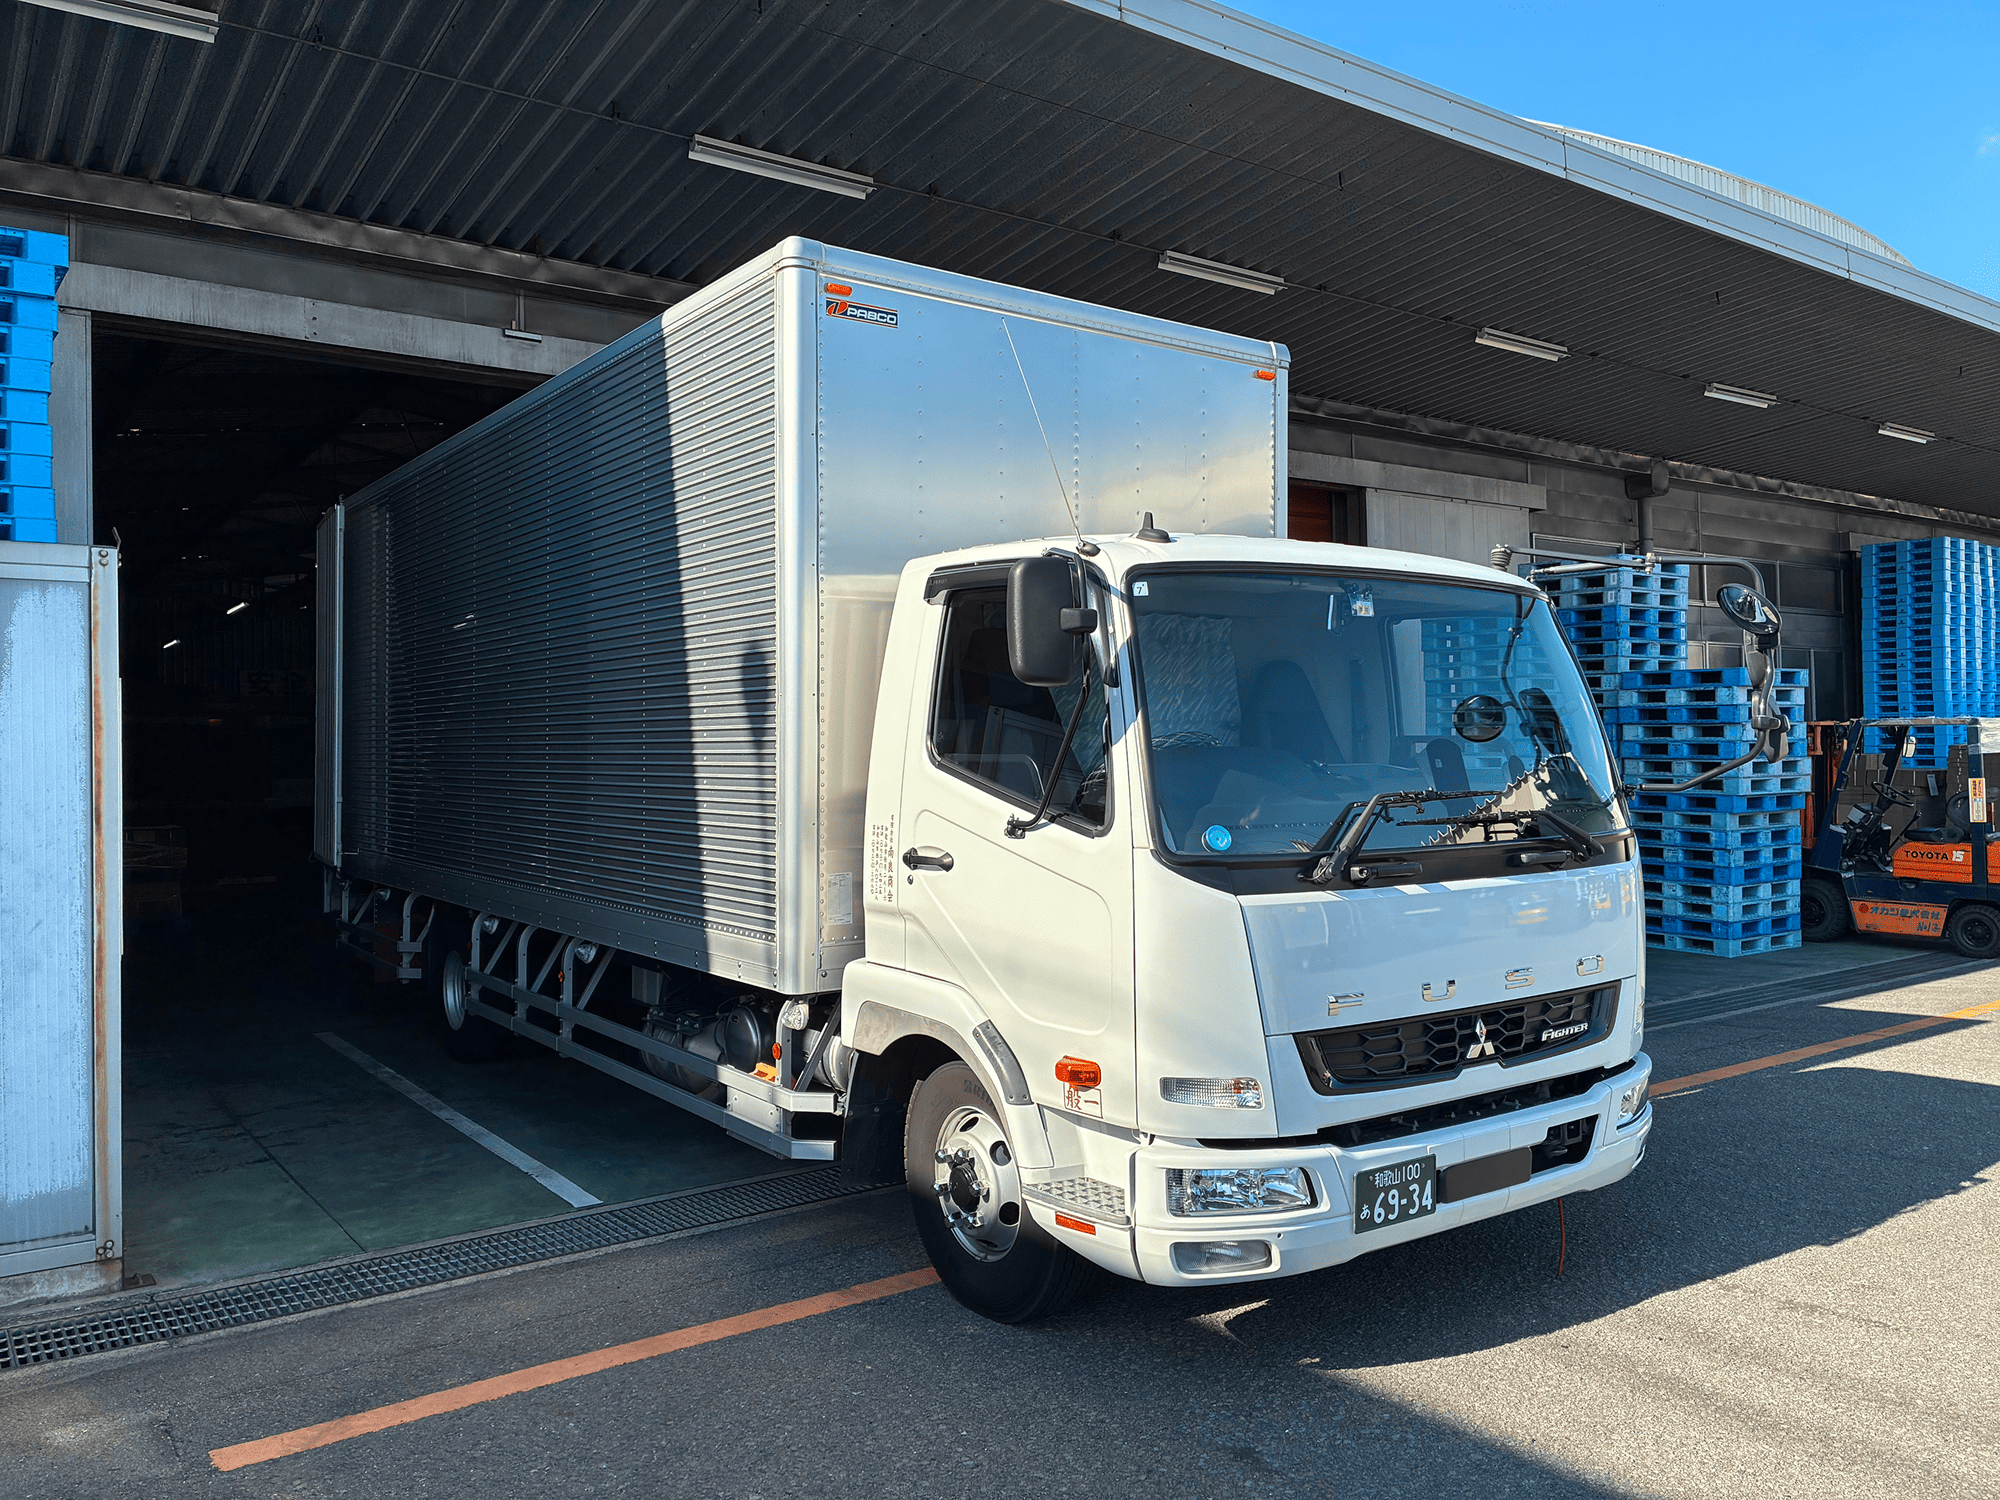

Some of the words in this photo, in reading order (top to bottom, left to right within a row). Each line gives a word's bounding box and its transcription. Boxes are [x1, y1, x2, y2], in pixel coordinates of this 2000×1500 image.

[847, 307, 896, 324] PABCO
[1904, 850, 1949, 861] TOYOTA
[1326, 954, 1605, 1016] FUSO
[1374, 1167, 1400, 1188] 和歌山
[1403, 1163, 1420, 1182] 100
[1359, 1203, 1371, 1220] あ
[1373, 1180, 1433, 1224] 69-34
